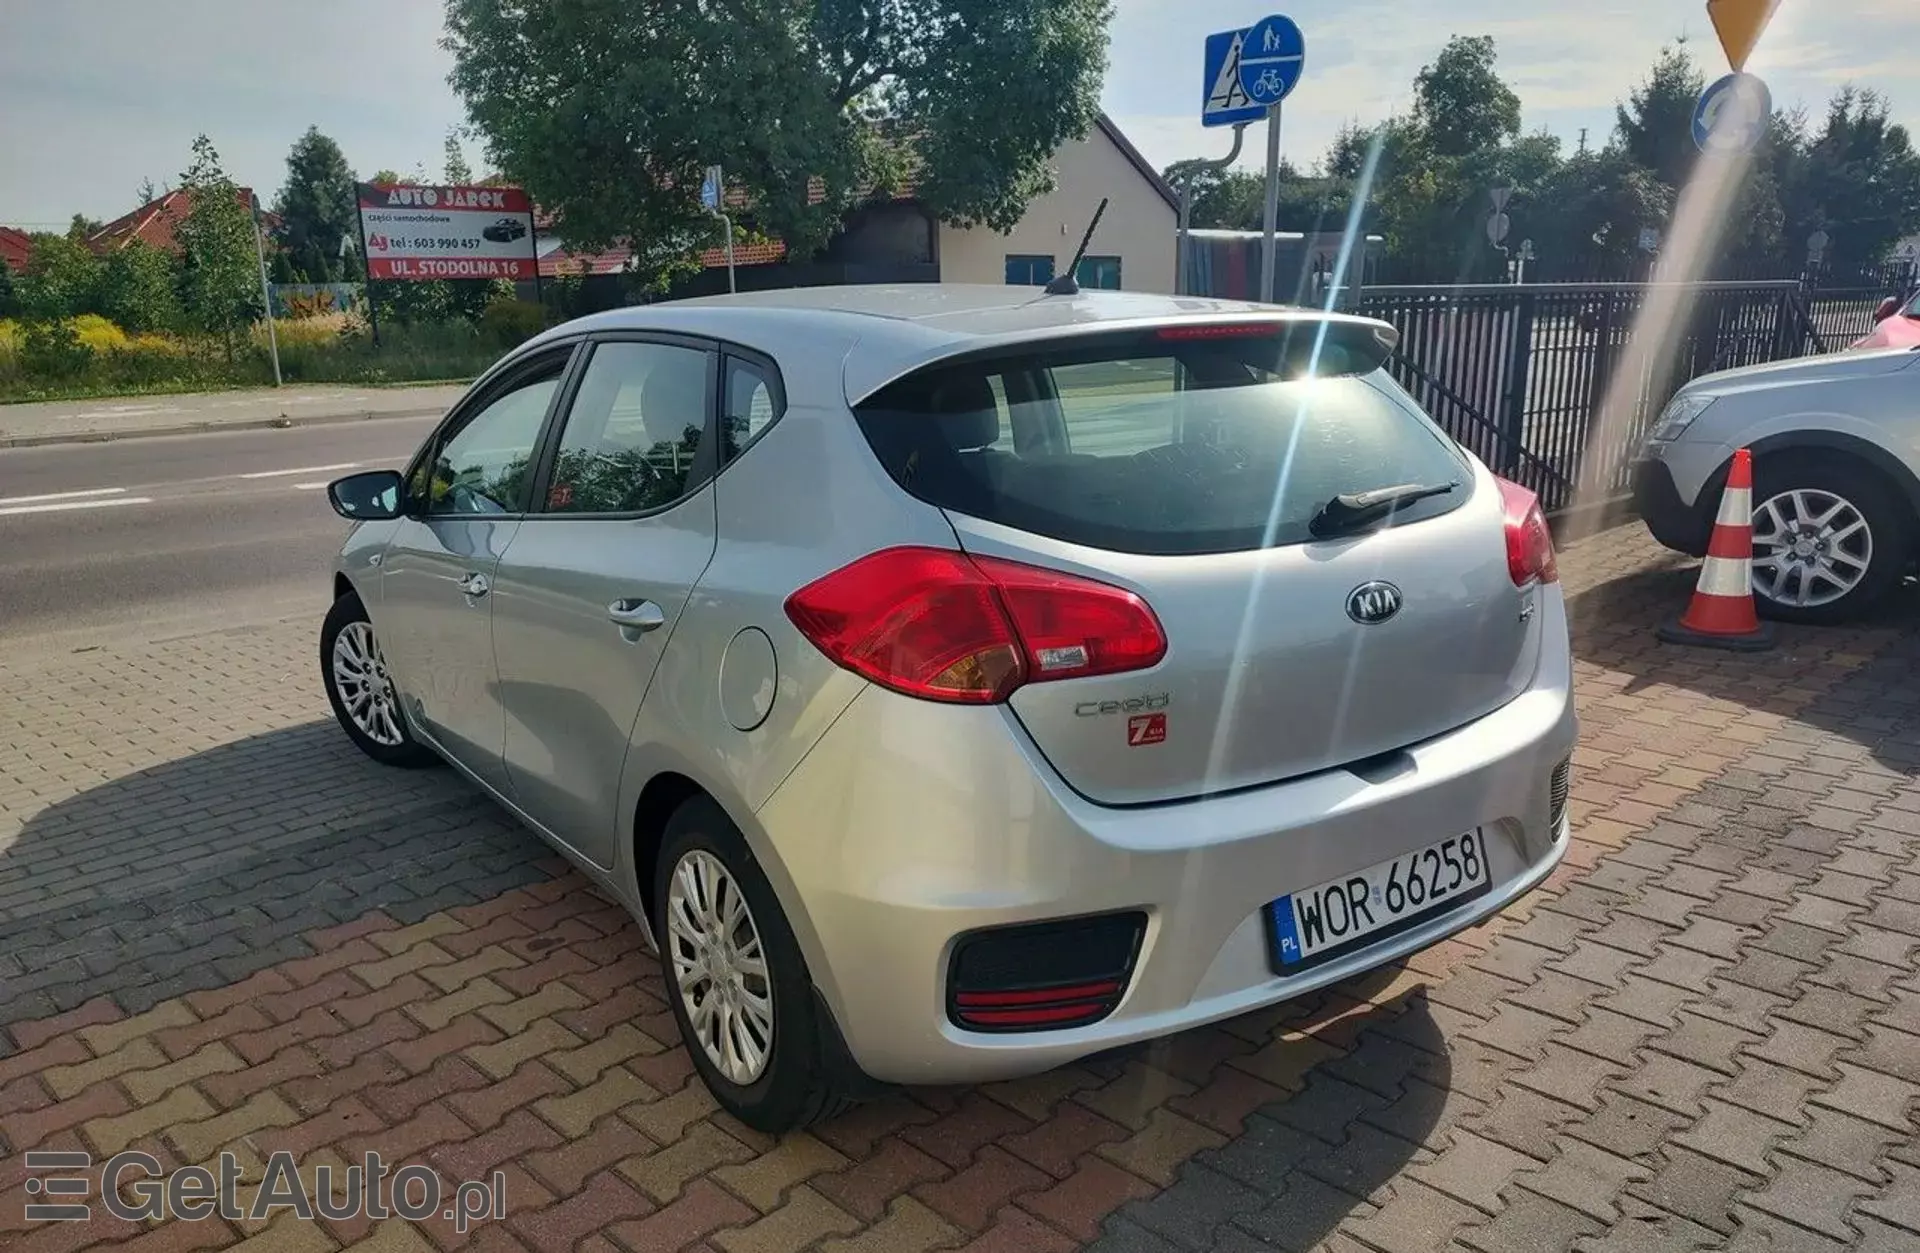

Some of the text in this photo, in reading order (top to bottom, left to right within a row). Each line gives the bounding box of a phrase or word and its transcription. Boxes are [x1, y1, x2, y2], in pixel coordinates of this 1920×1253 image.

[388, 189, 438, 205] AUTO
[414, 238, 435, 248] 603
[437, 238, 459, 248] 990
[461, 239, 480, 248] 457
[391, 261, 519, 275] UL. STODOLNA 16
[1357, 590, 1396, 617] KIA
[1296, 834, 1480, 948] WOR 66258
[1281, 937, 1298, 952] PL
